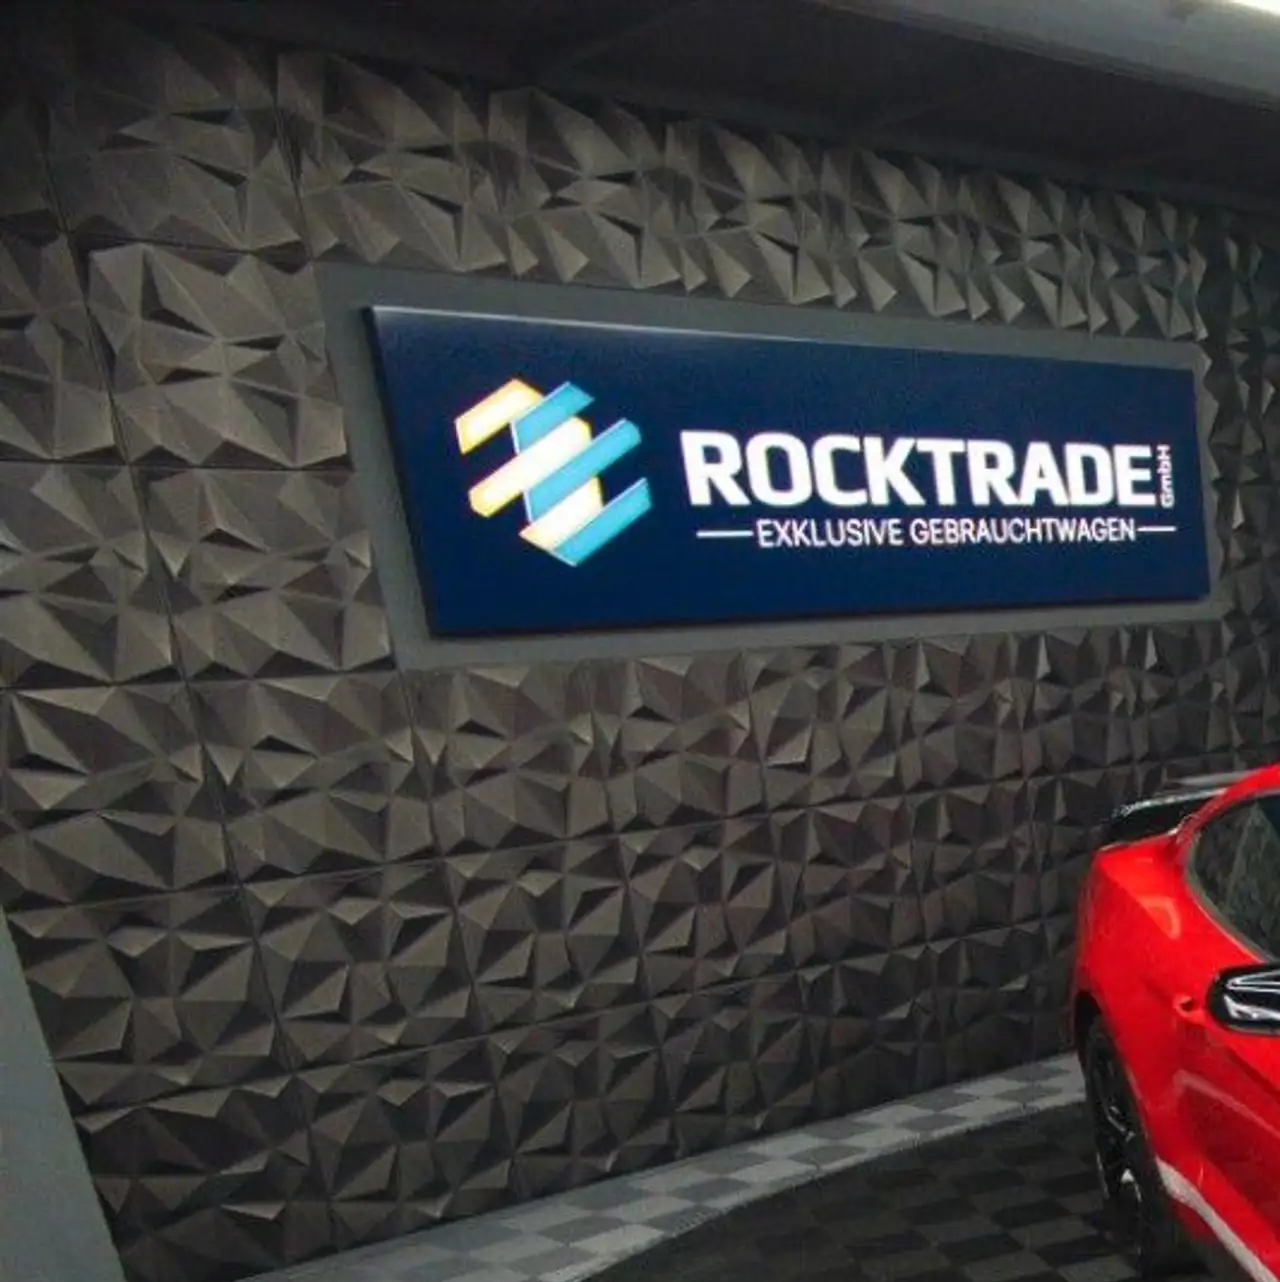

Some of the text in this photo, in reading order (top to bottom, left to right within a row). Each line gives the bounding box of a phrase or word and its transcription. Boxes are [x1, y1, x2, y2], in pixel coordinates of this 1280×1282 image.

[680, 430, 1157, 506] ROCKTRADE
[1157, 444, 1175, 509] GmbH
[756, 517, 1136, 548] EXKLUSIVE GEBRAUCHTWAGEN
